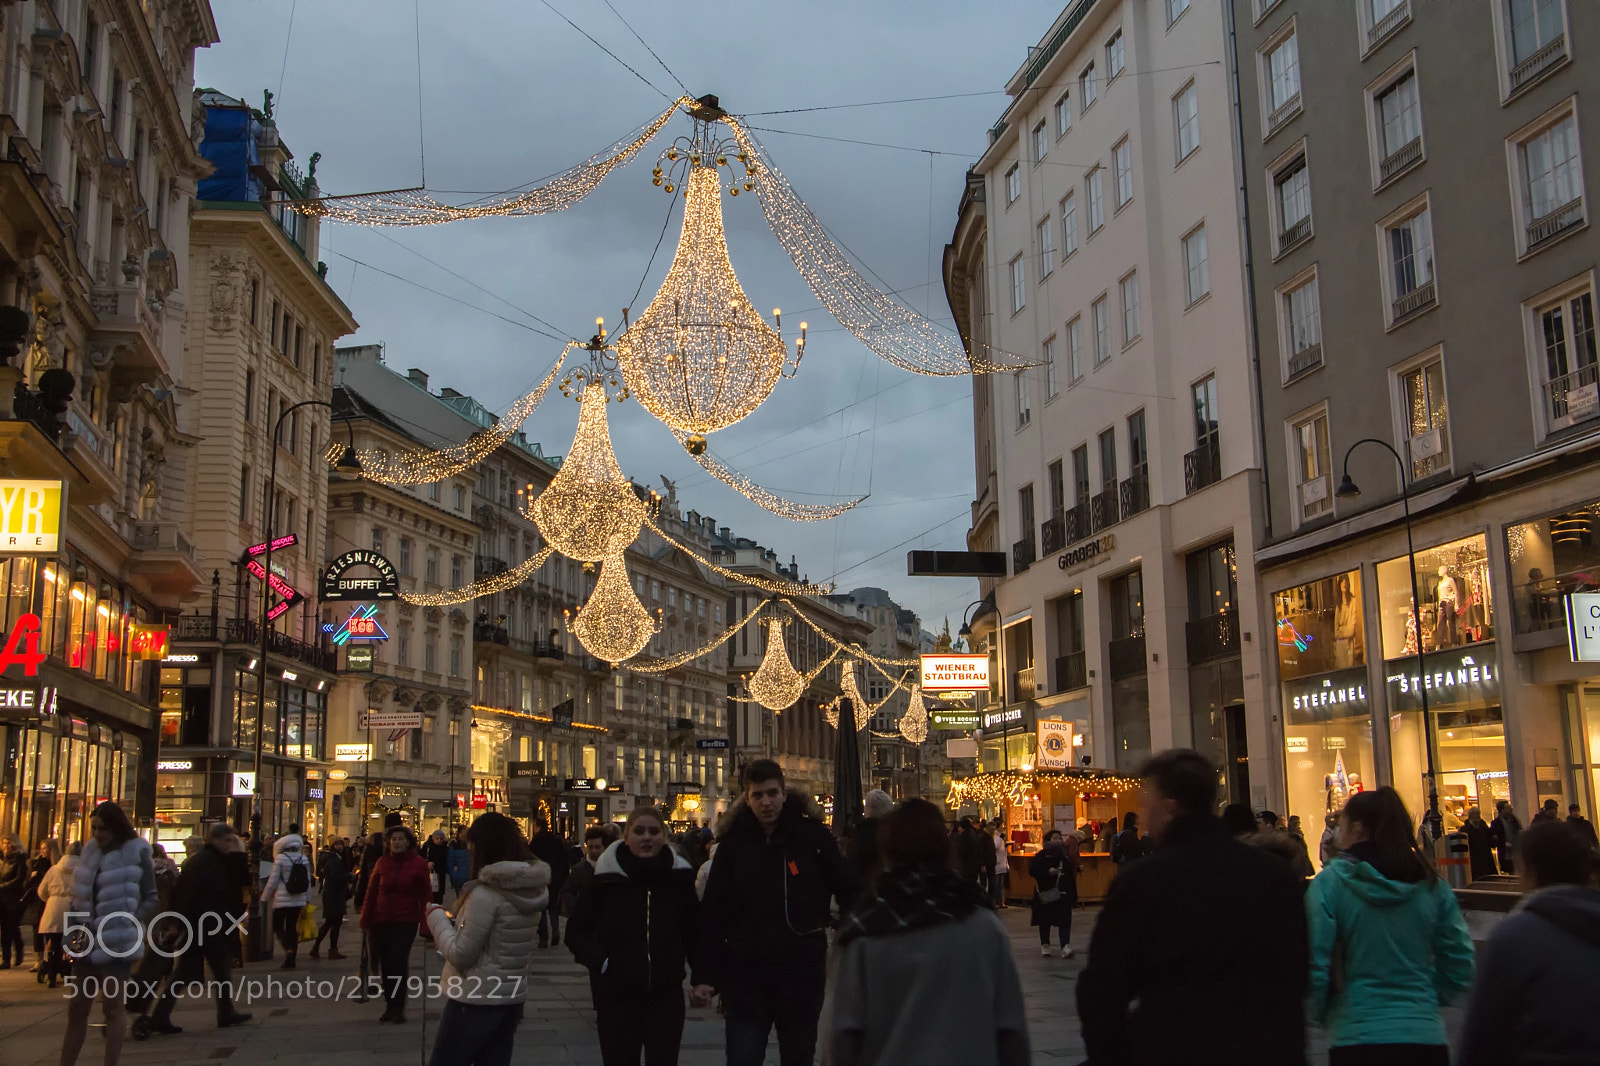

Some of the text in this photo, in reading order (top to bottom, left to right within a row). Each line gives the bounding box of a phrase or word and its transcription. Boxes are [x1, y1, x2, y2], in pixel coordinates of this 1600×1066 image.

[0, 487, 45, 534] YR
[249, 535, 295, 554] DISCOHEQUE
[1058, 540, 1099, 569] GRABEN
[246, 560, 295, 600] FLEDRMAUS
[339, 580, 381, 590] BUFFET
[1400, 665, 1493, 693] STEFANEL
[1293, 686, 1366, 710] STEFANEL
[990, 712, 1001, 724] YVES
[1043, 722, 1067, 731] LIONS
[701, 740, 726, 748] Berlitz
[1039, 758, 1070, 767] PUNSCH
